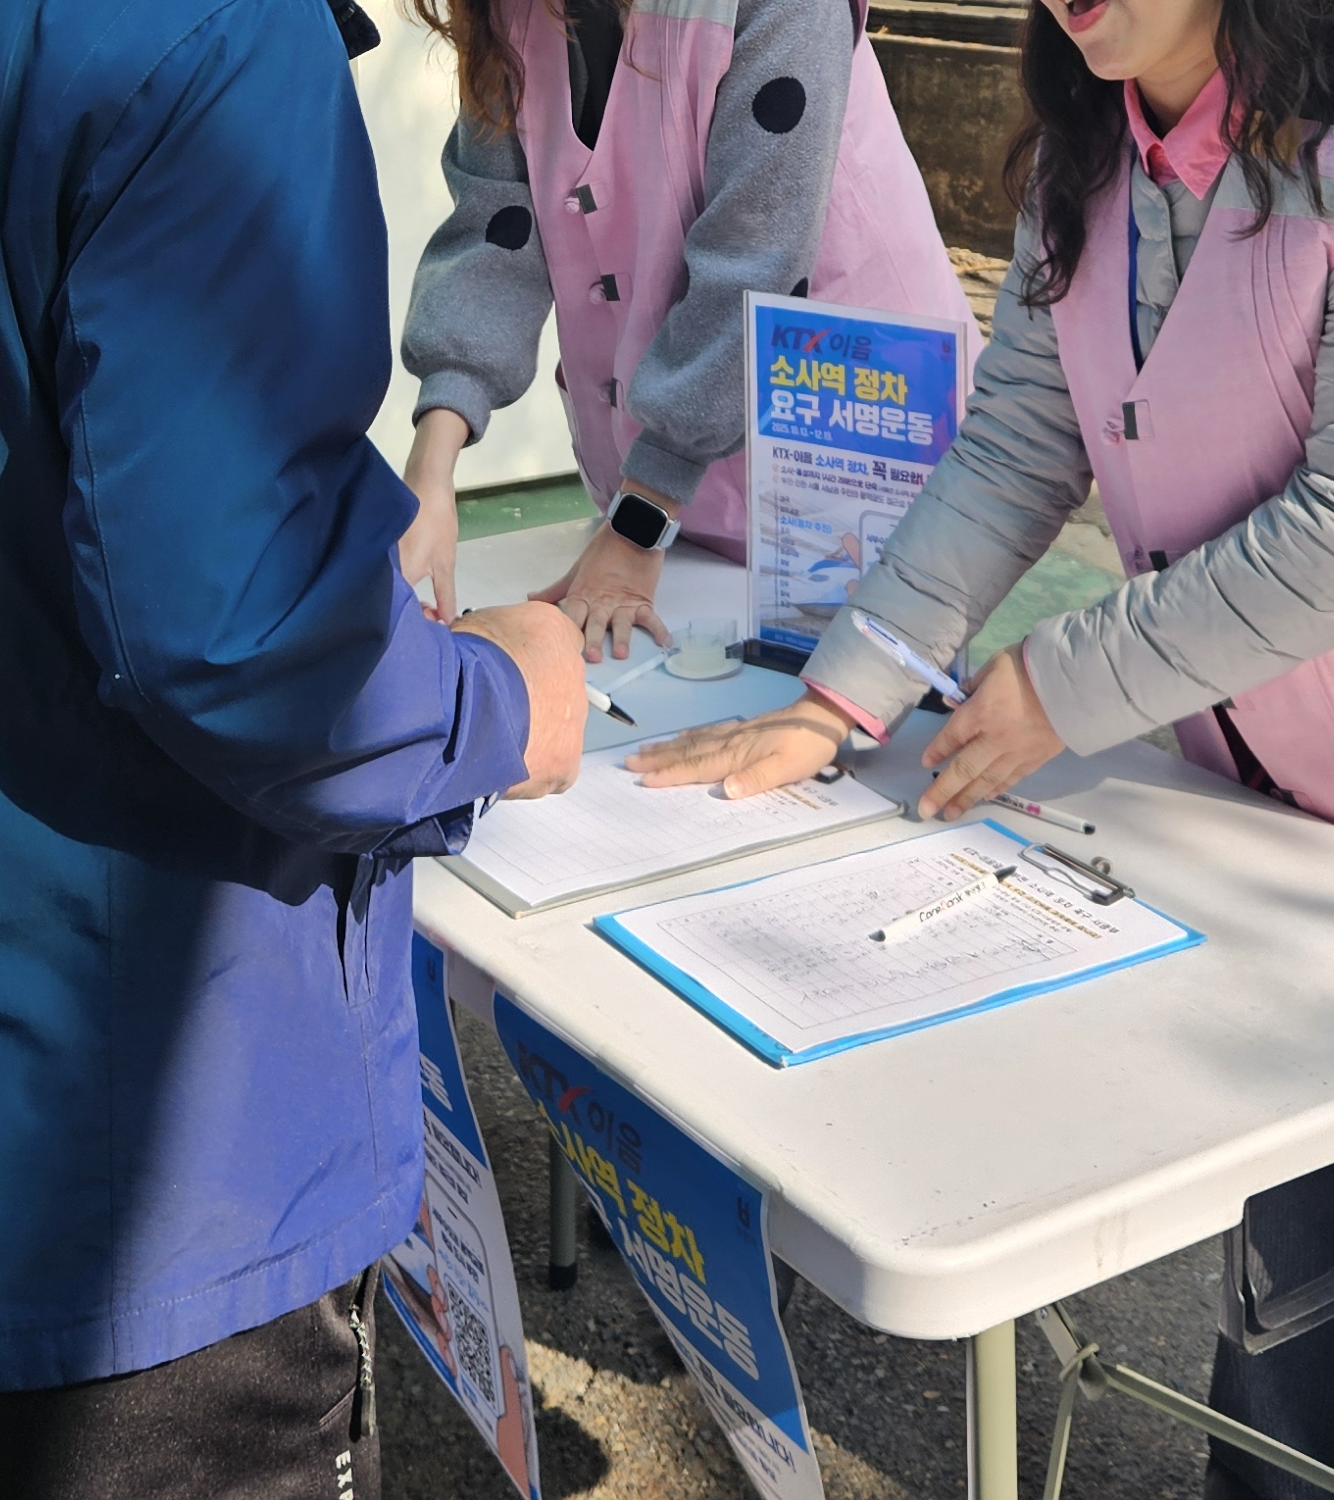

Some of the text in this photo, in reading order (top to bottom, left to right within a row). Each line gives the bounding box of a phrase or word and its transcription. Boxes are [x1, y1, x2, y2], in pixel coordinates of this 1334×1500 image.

[771, 324, 872, 361] KTX 이음
[770, 355, 908, 406] 소사역 정차
[770, 389, 934, 446] 요구 서명운동
[815, 454, 845, 471] 소사역
[872, 459, 887, 481] 꼭
[586, 1101, 644, 1176] 이음
[626, 1178, 707, 1285] 정차
[617, 1217, 760, 1382] 서명운동
